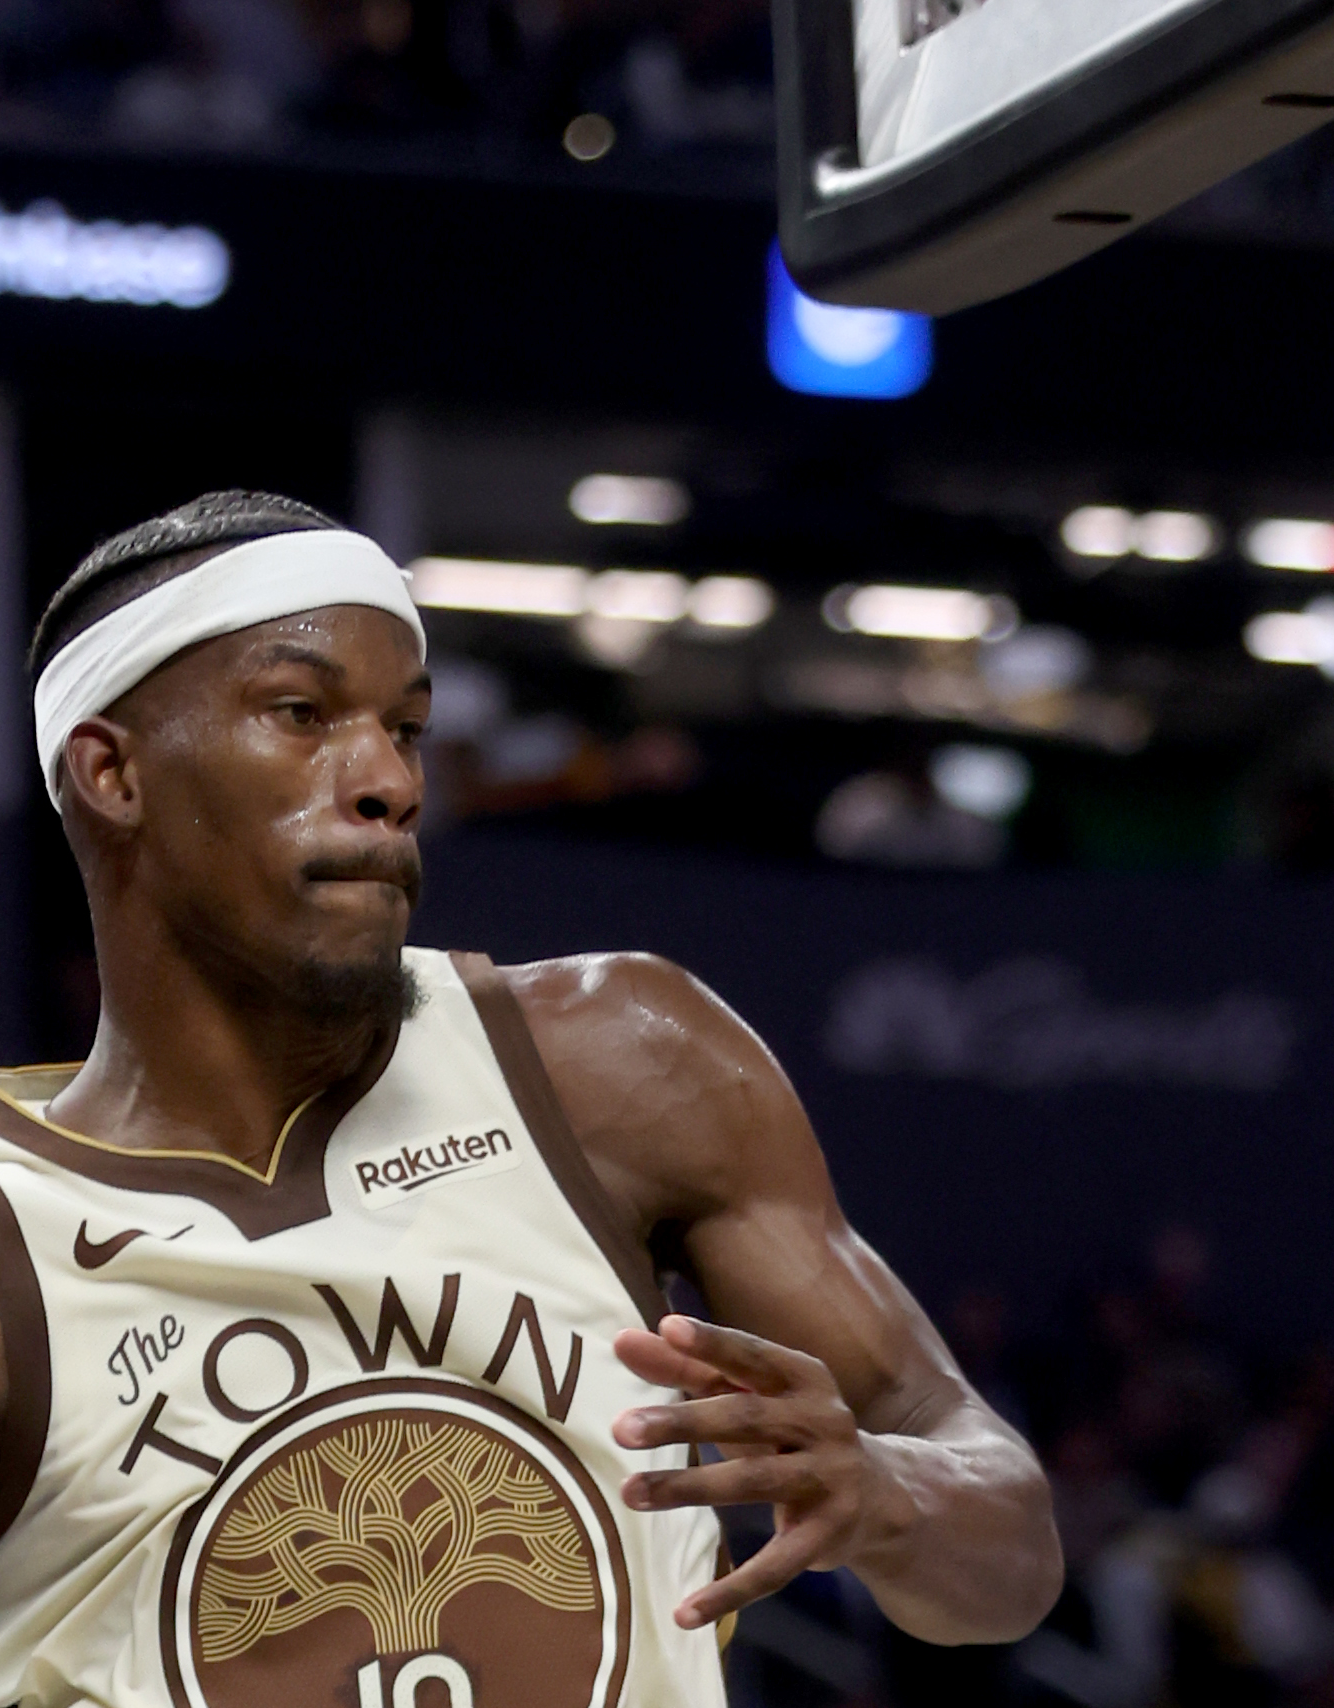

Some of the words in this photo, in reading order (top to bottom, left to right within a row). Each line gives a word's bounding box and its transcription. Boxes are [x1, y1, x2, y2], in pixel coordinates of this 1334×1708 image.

[355, 1128, 513, 1194] Rakuten
[107, 1313, 187, 1406] The
[118, 1272, 583, 1478] TOWN
